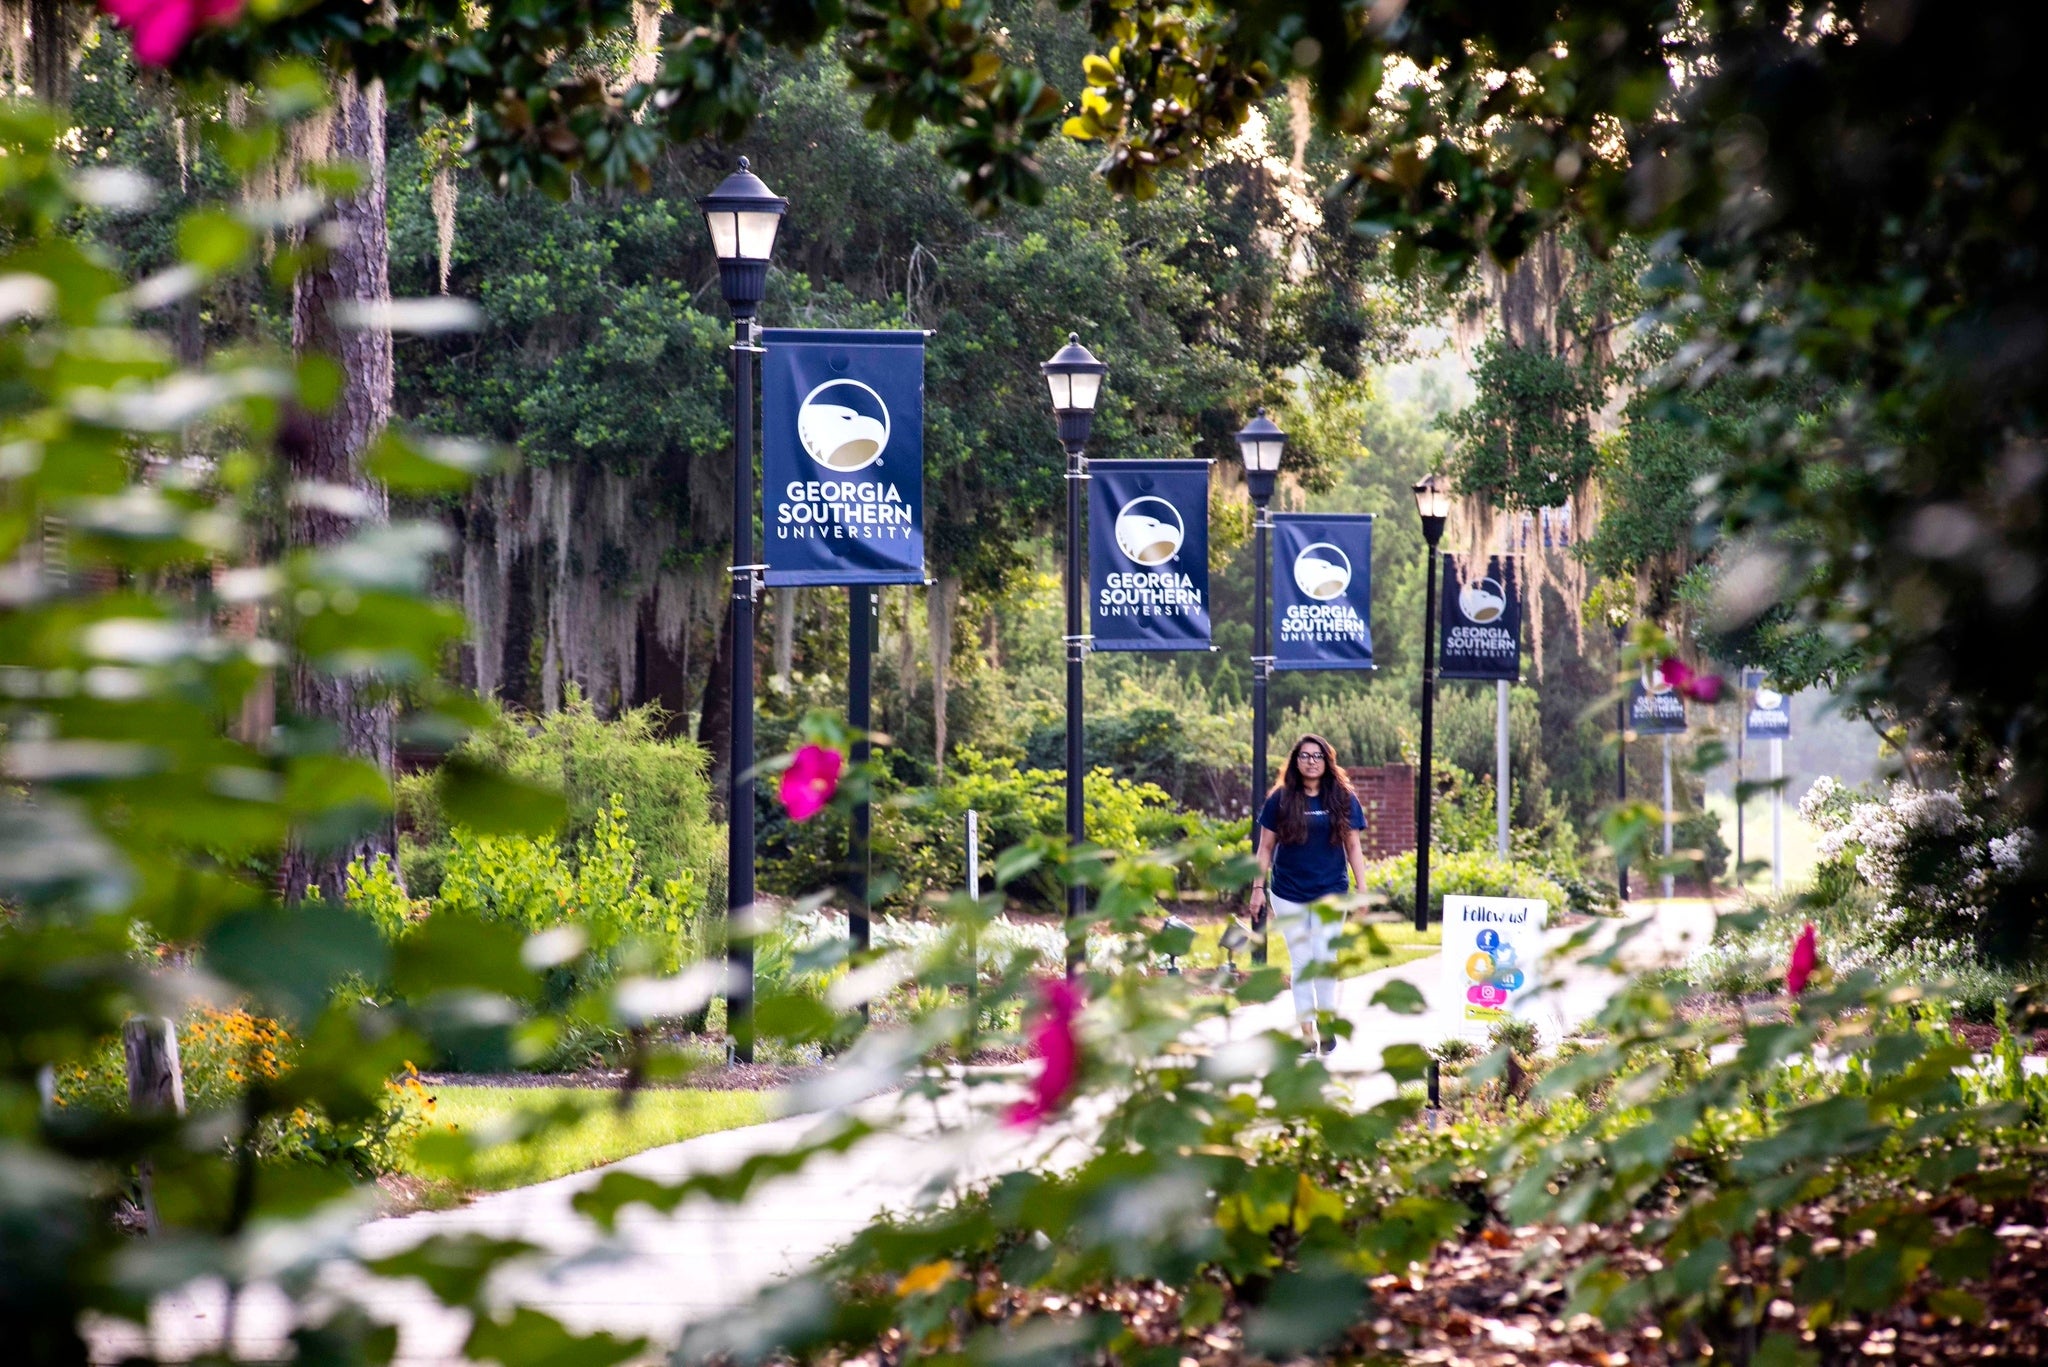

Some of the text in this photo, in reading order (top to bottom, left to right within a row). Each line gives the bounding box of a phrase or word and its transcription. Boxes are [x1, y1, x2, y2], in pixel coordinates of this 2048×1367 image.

[786, 481, 903, 503] GEORGIA
[777, 502, 912, 525] SOUTHERN
[777, 525, 912, 539] UNIVERSITY
[1106, 572, 1194, 589] GEORGIA
[1100, 588, 1202, 605] SOUTHERN
[1100, 605, 1202, 616] UNIVERSITY
[1286, 605, 1359, 620] GEORGIA
[1281, 618, 1365, 632] SOUTHERN
[1281, 632, 1364, 642] UNIVERSITY
[1451, 626, 1511, 639] GEORGIA
[1446, 636, 1516, 650] SOUTHERN
[1446, 648, 1515, 658] UNIVERSITY
[1463, 904, 1528, 923] Follow us!
